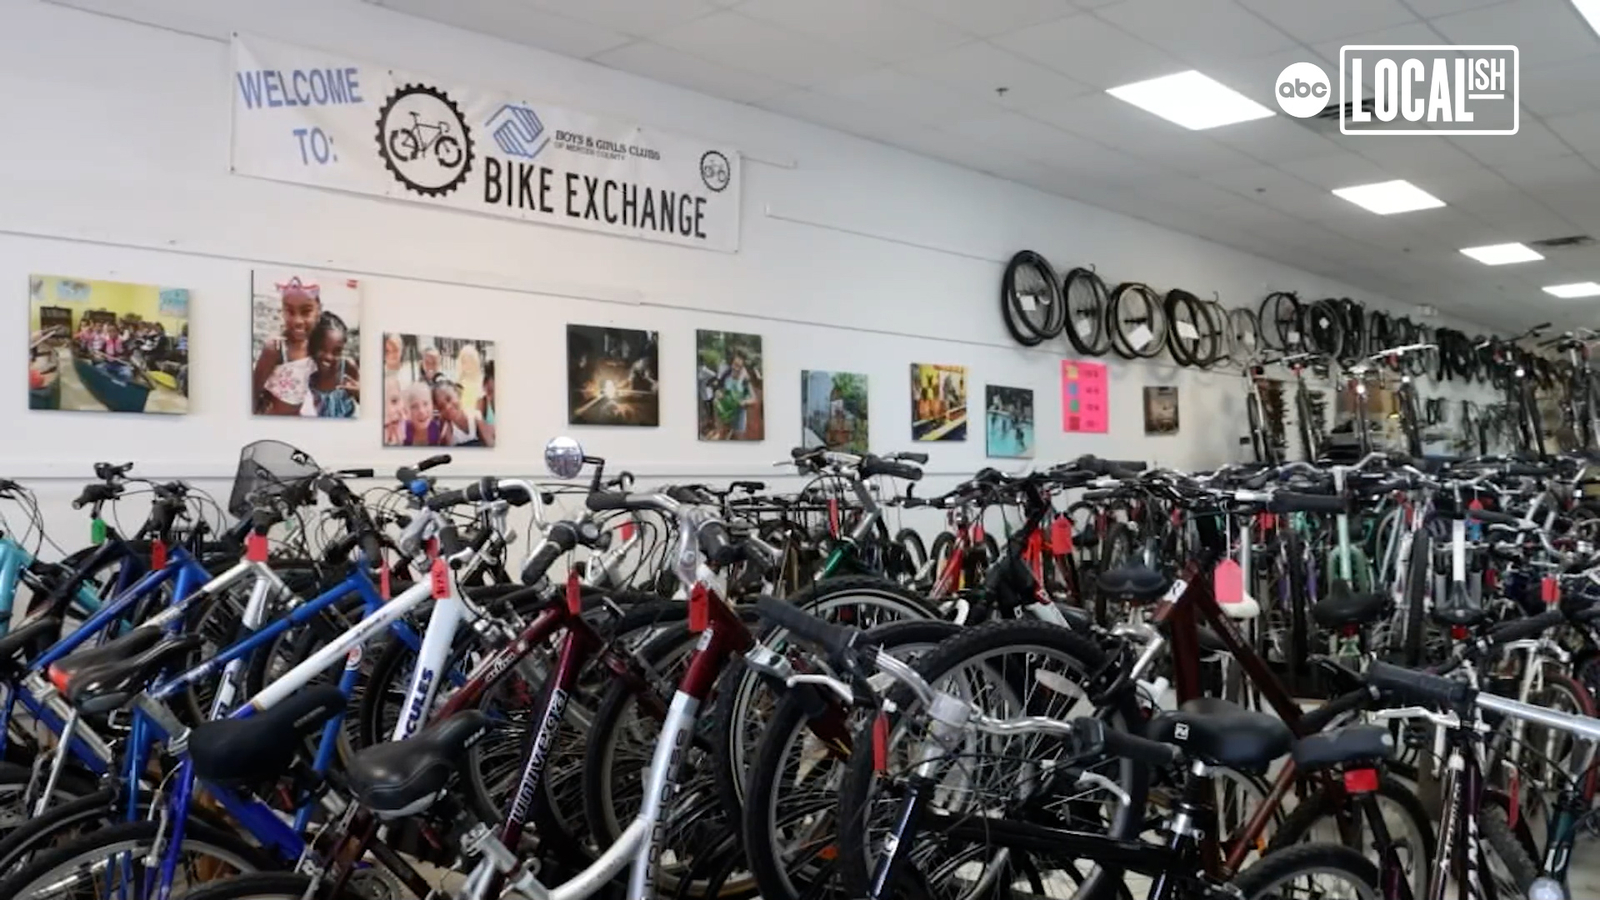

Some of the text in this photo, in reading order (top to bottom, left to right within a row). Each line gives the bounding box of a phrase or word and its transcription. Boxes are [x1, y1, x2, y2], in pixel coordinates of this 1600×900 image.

[236, 67, 364, 110] WELCOME
[292, 126, 338, 166] TO:
[555, 129, 662, 161] BOYS & GIRLS CLUBS
[484, 155, 708, 240] BIKE EXCHANGE
